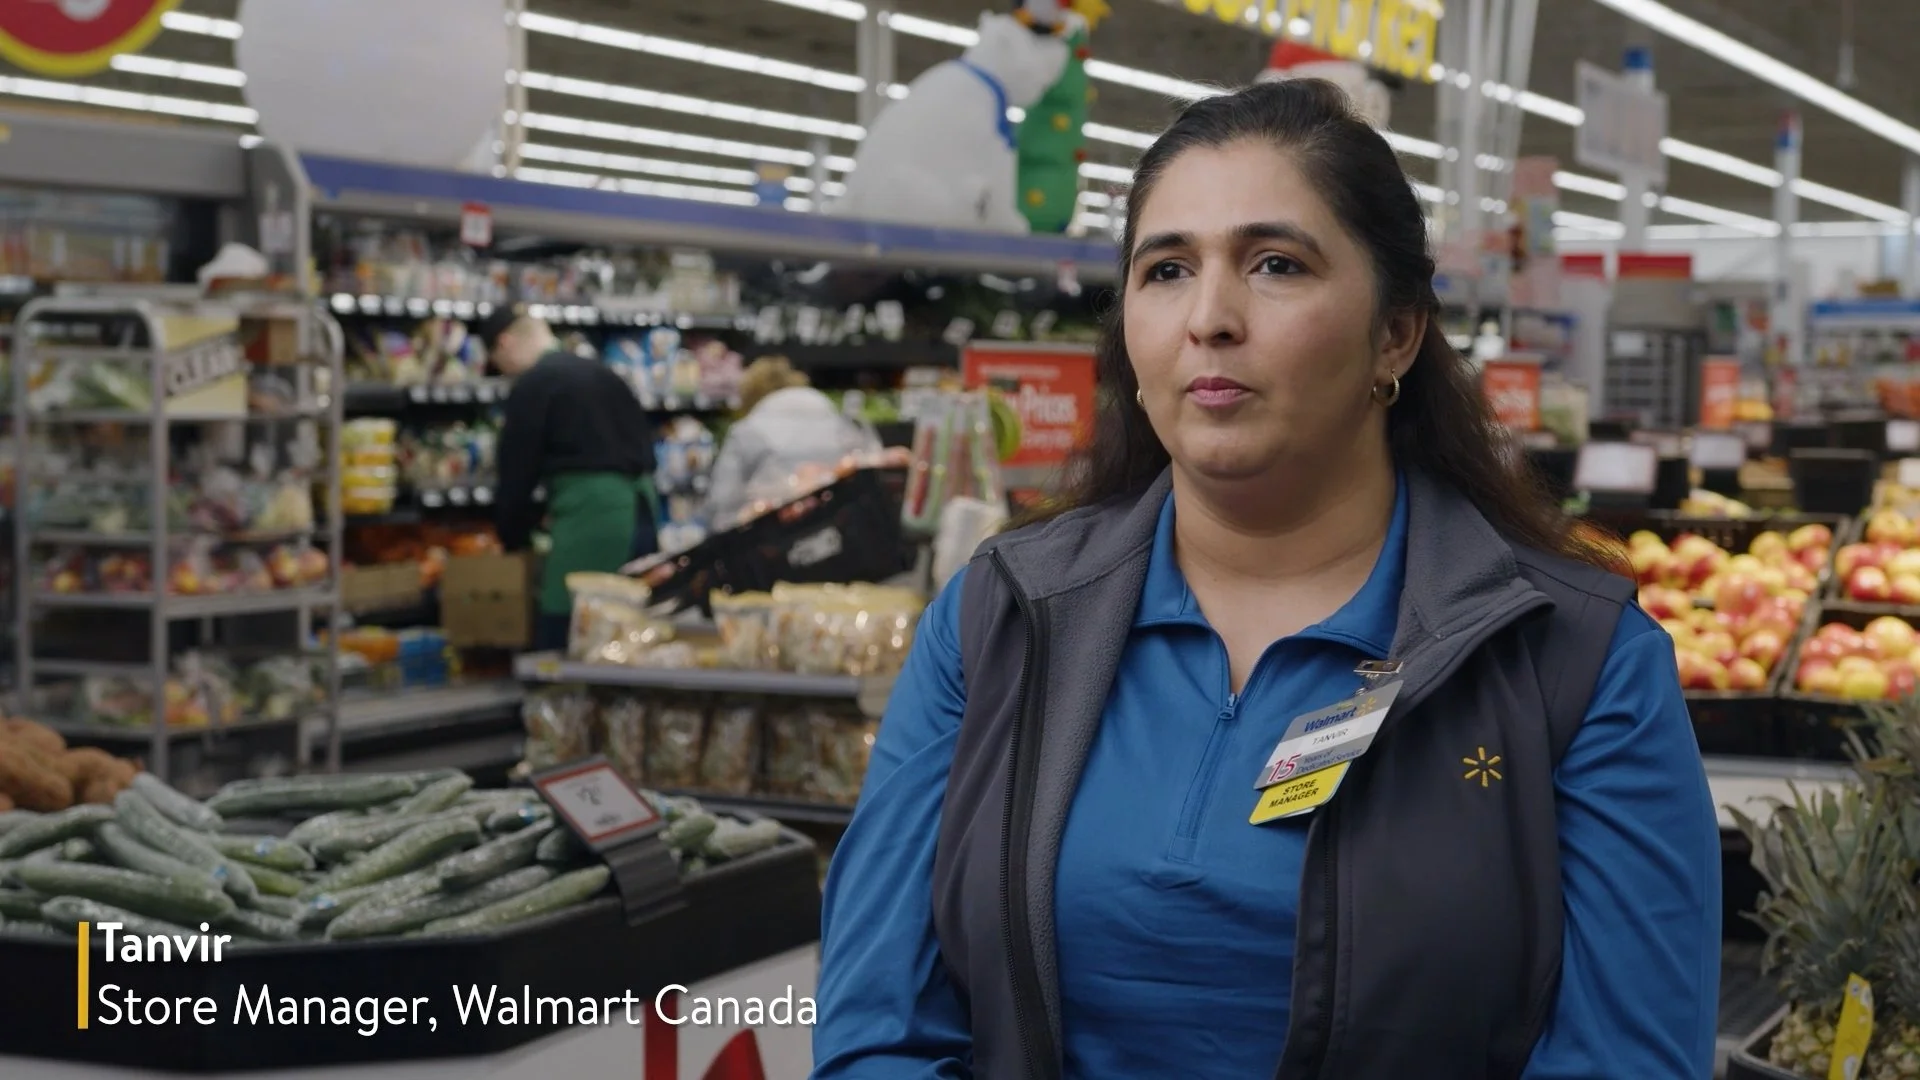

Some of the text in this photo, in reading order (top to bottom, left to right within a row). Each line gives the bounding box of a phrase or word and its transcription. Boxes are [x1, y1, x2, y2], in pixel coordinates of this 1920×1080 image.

[1304, 707, 1357, 732] Walmart
[1313, 728, 1349, 745] TANVIR
[1267, 753, 1302, 785] 15
[1268, 787, 1320, 808] MANAGER
[1282, 779, 1317, 795] STORE
